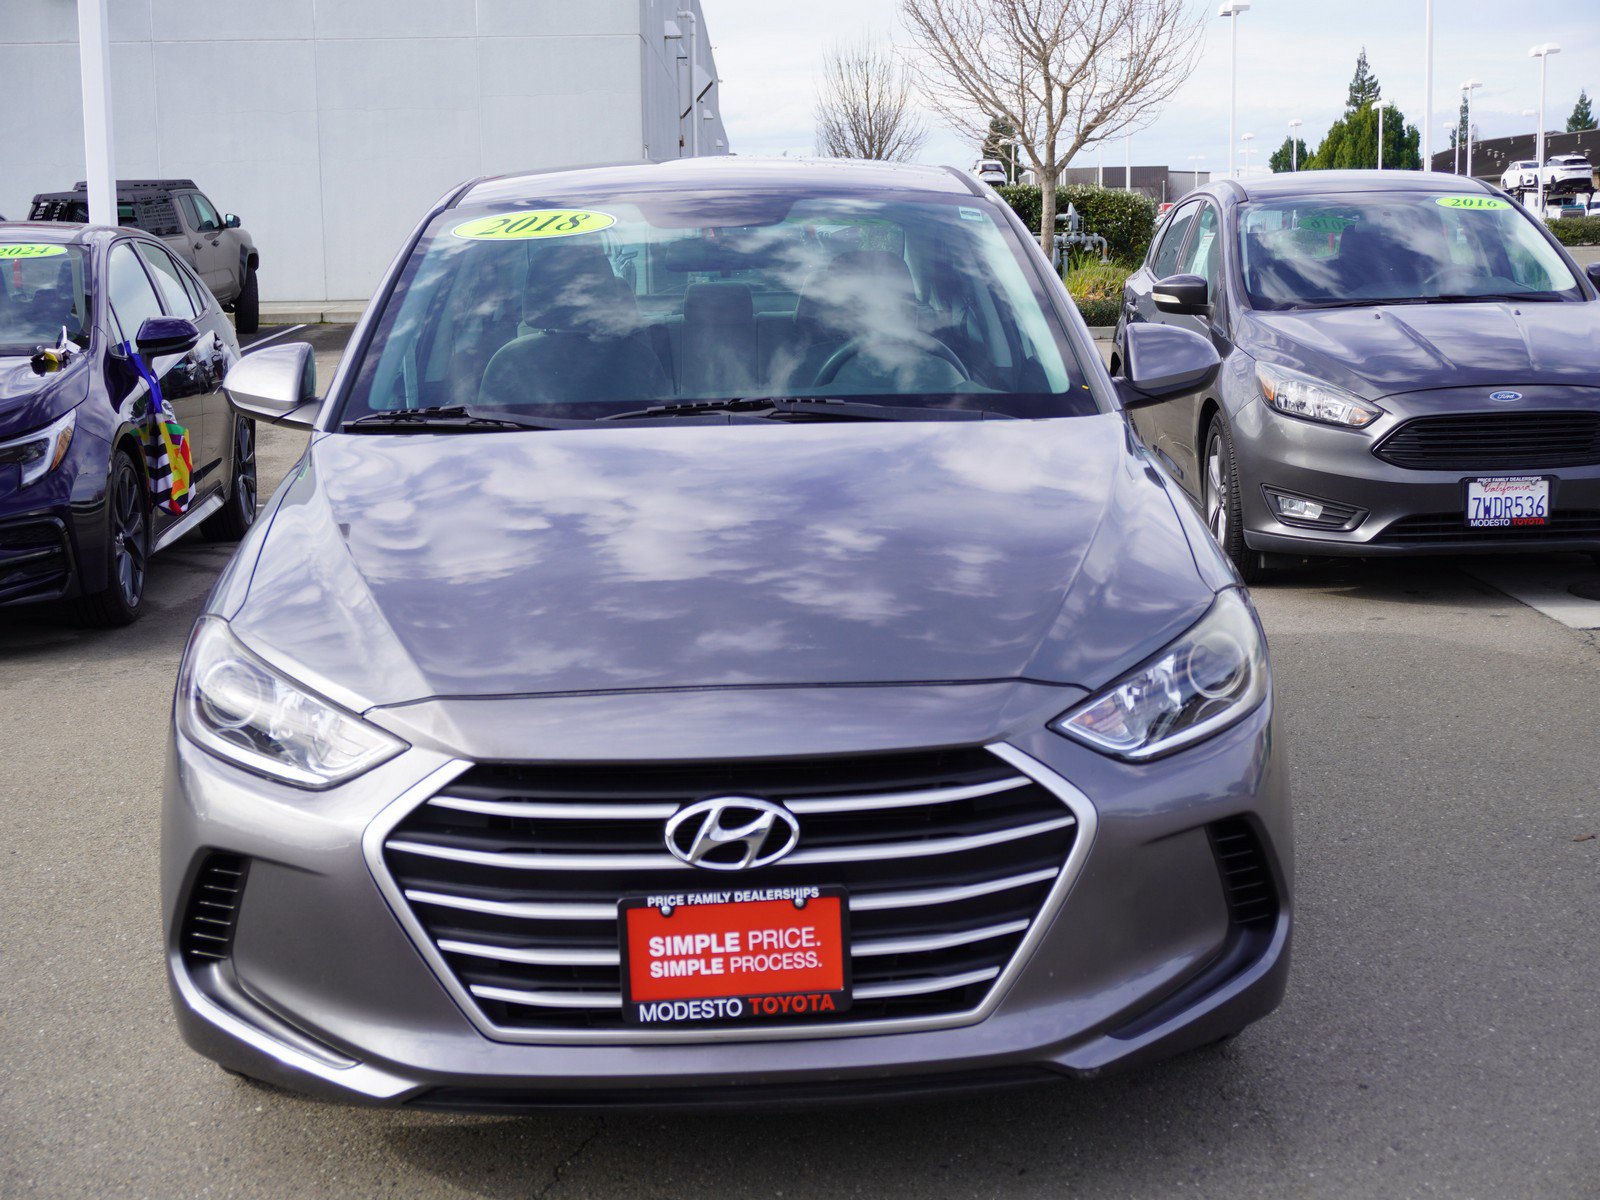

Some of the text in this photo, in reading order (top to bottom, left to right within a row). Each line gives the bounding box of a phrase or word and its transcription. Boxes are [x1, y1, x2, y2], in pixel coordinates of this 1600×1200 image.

[1451, 198, 1498, 208] 2016
[475, 213, 590, 236] 2018
[1484, 481, 1535, 496] California
[1472, 495, 1546, 519] 7WDR536
[1470, 517, 1545, 527] MODESTO TOYOTA
[647, 887, 820, 908] PRICE FAMILY DEALERSHIPS
[649, 926, 822, 957] SIMPLE PRICE.
[650, 951, 823, 978] SIMPLE PROCESS.
[639, 993, 836, 1022] MODESTO TOYOTA
